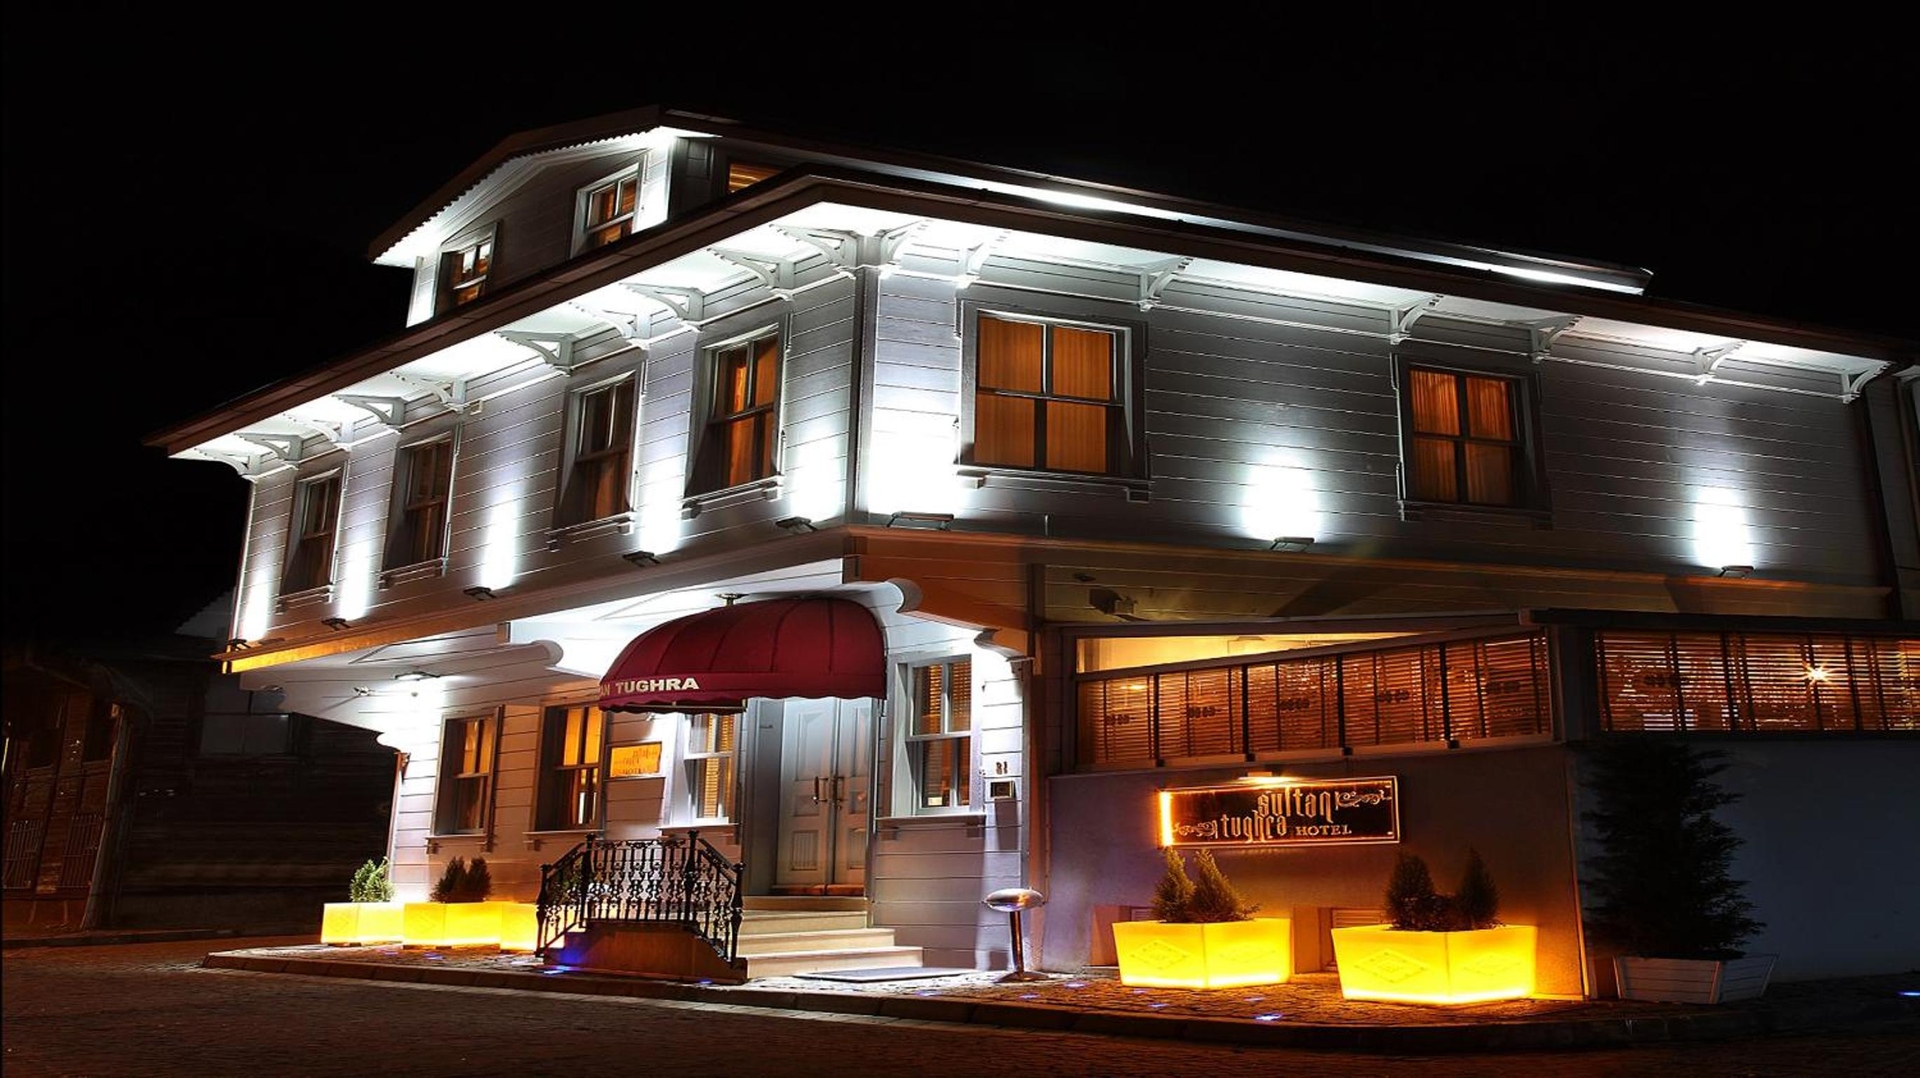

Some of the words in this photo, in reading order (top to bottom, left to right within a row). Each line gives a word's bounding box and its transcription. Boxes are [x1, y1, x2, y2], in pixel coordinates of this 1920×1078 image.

[615, 677, 700, 694] TUGHRA
[1257, 786, 1334, 823] sultan
[1295, 824, 1352, 836] HOTEL
